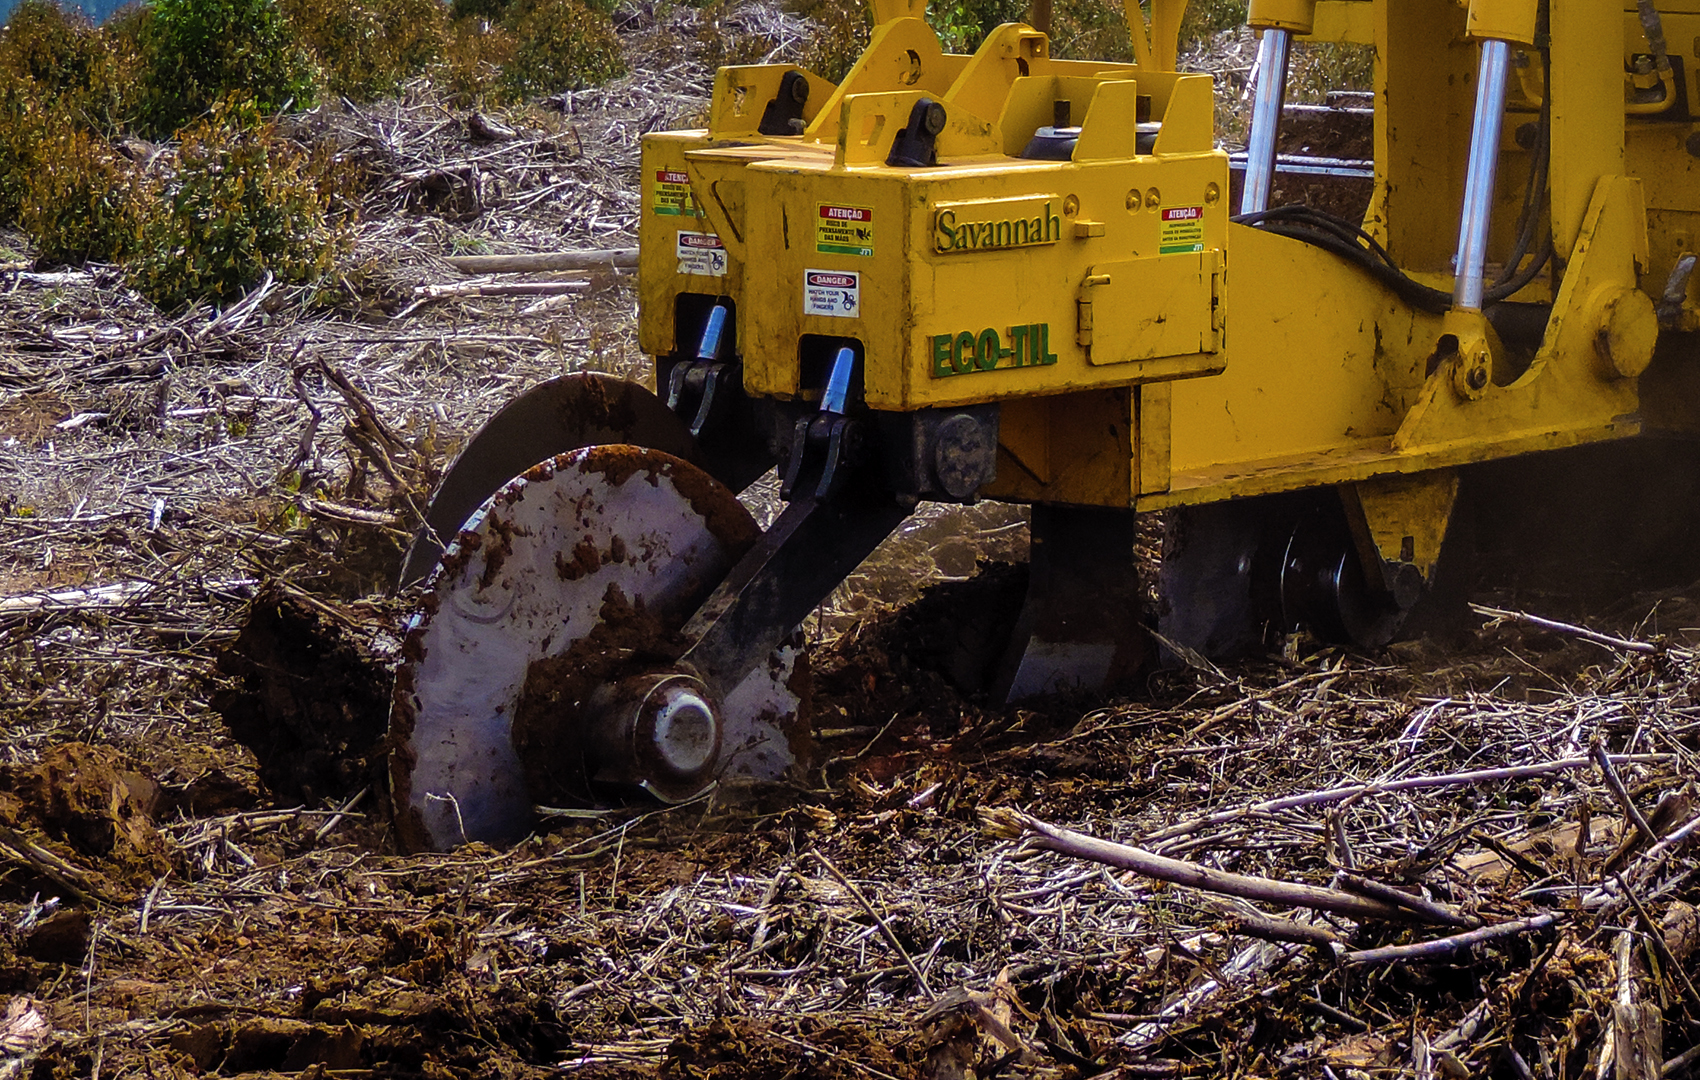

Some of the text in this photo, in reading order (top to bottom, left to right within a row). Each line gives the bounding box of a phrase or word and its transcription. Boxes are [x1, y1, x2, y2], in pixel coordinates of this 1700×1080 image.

[665, 173, 689, 184] ATENÇ
[1169, 207, 1196, 219] ATENÇÃO
[826, 219, 840, 227] RISCO
[936, 200, 1061, 252] Savannah
[816, 276, 847, 285] DANGER
[811, 303, 834, 311] FINGERS
[928, 322, 1058, 379] ECO-TIL
